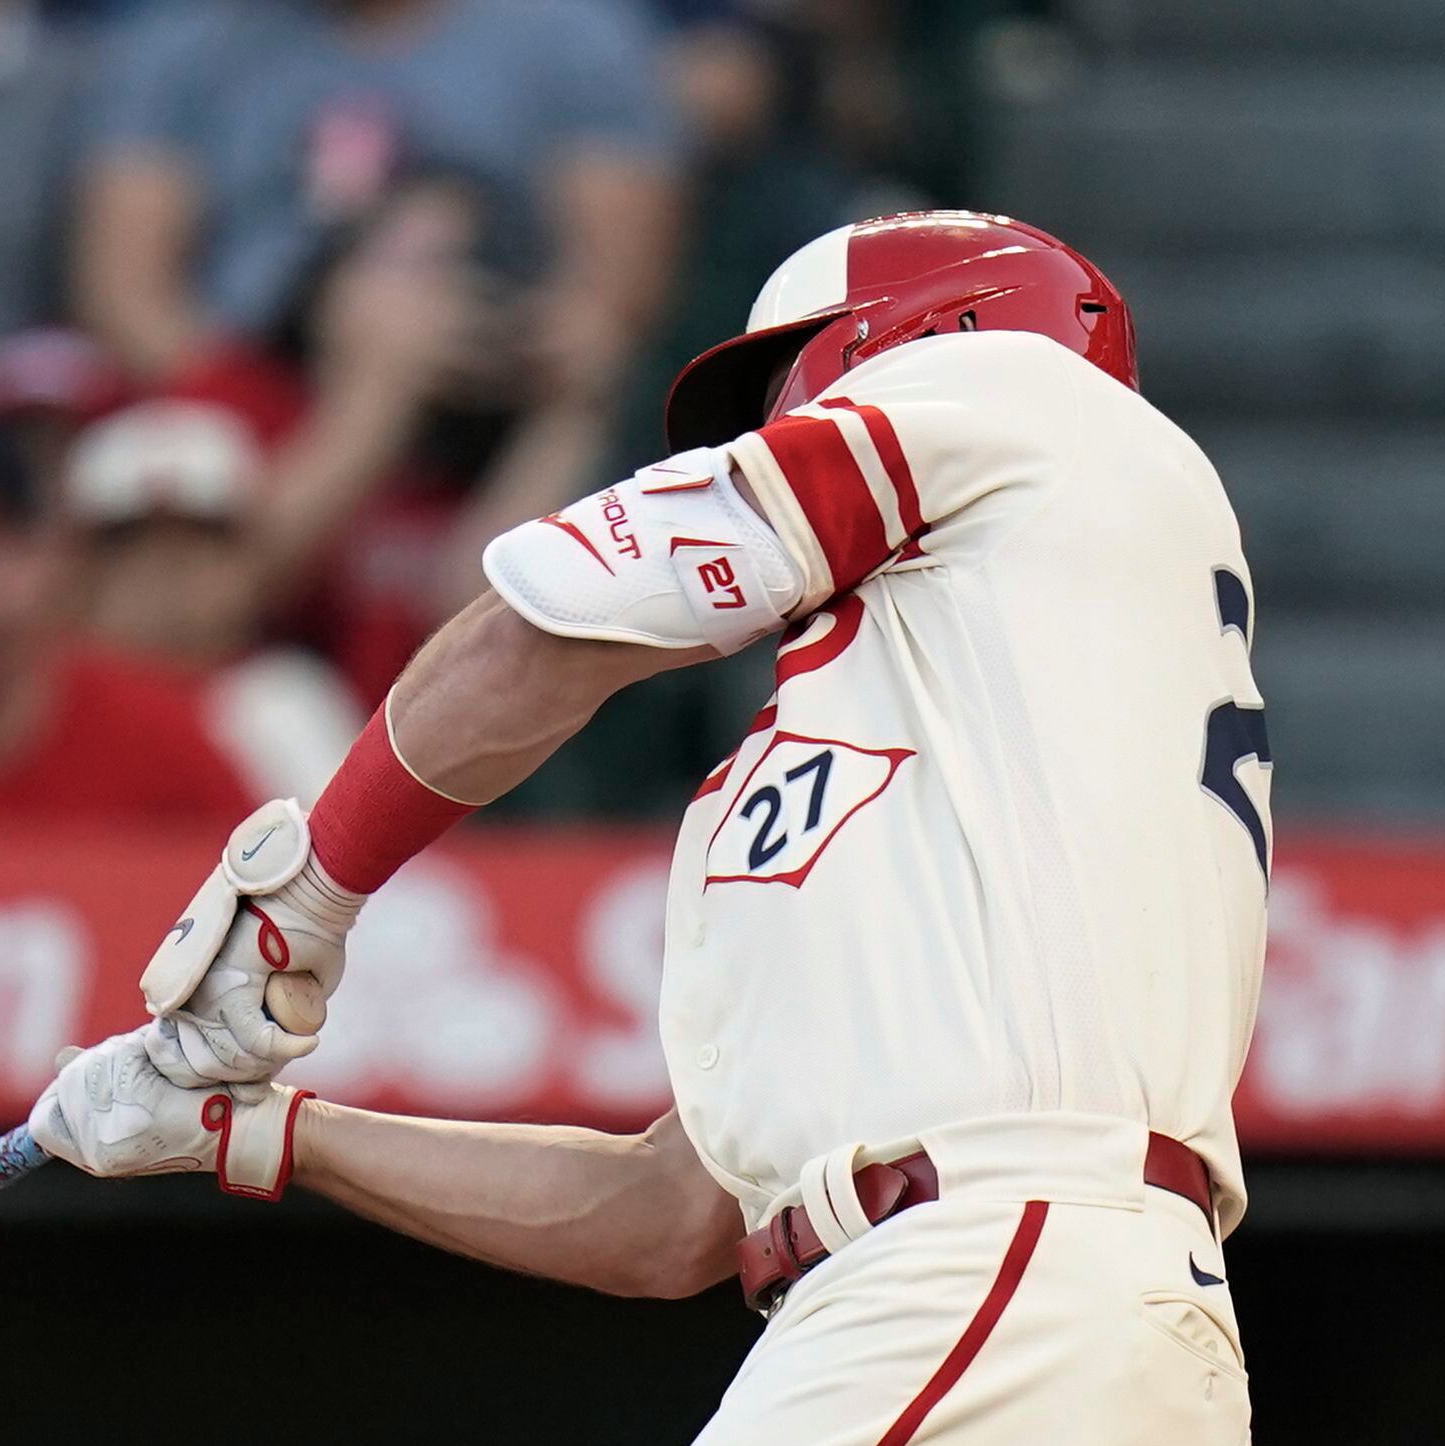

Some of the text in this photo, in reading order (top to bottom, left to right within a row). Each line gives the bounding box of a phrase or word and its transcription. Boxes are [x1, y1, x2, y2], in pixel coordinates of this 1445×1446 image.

[598, 489, 642, 559] ROUT
[697, 556, 747, 610] 27
[738, 748, 835, 872] 27
